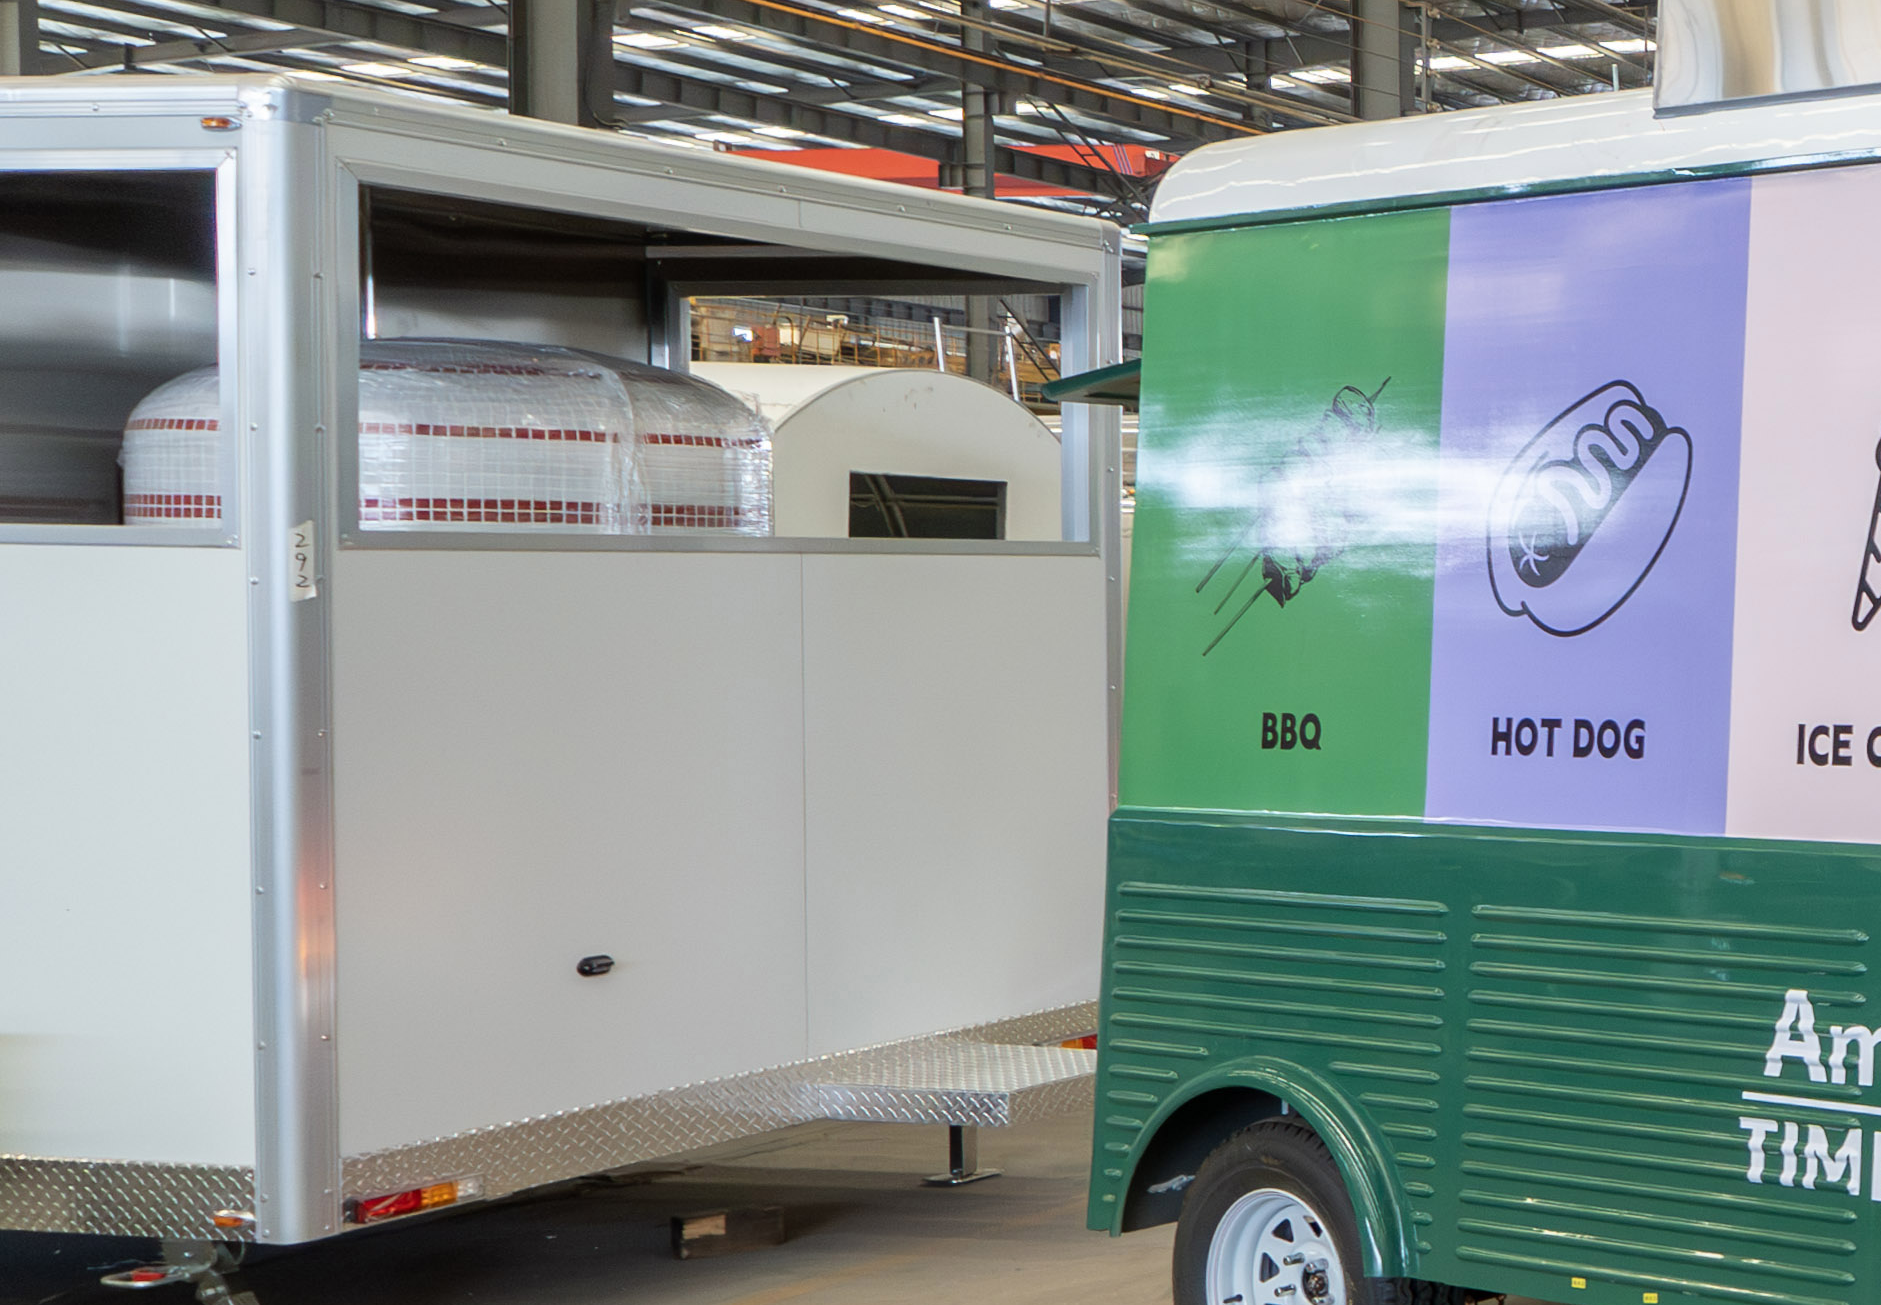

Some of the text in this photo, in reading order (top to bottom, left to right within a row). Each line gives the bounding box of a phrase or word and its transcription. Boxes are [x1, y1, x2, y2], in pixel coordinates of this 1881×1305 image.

[294, 532, 312, 588] 292
[1261, 712, 1322, 750] BBQ
[1491, 717, 1646, 760] HOT DOG
[1797, 724, 1853, 766] ICE
